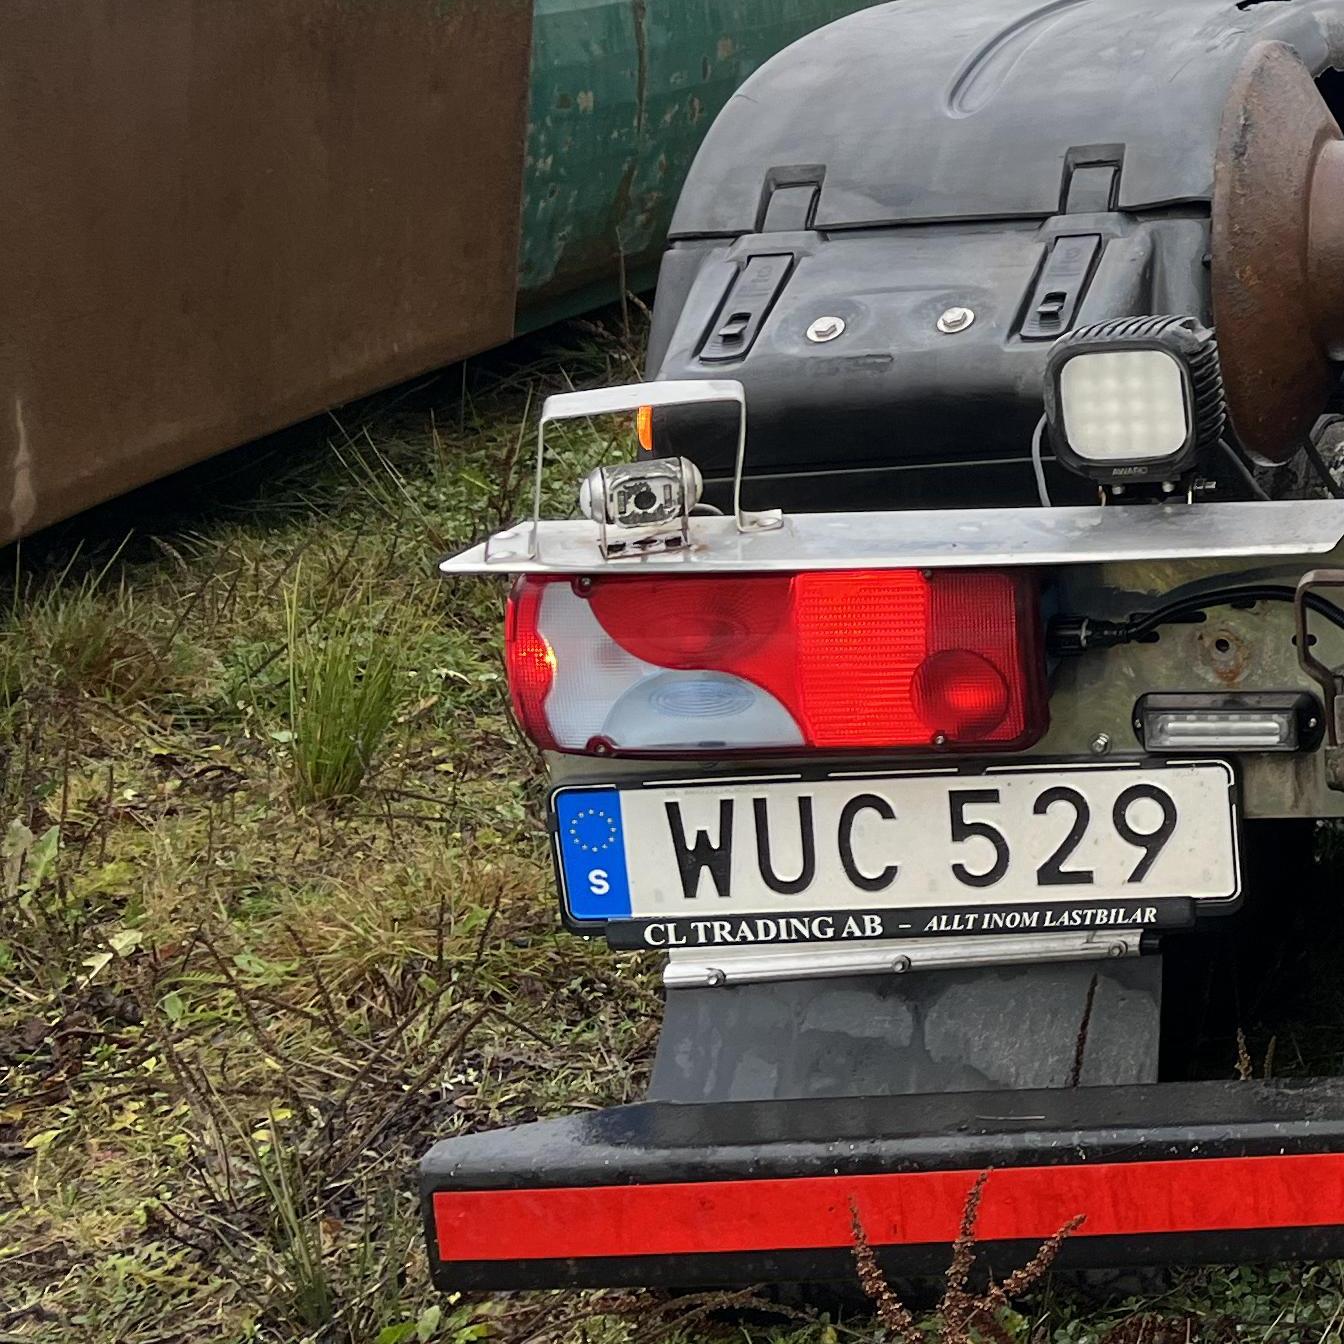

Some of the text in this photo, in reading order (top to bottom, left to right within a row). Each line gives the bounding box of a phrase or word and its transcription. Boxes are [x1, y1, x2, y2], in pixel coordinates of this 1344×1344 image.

[664, 783, 1178, 899] WUC 529
[588, 869, 611, 895] S
[643, 922, 687, 946] CL
[690, 917, 835, 944] TRADING
[841, 914, 884, 938] AB
[923, 914, 979, 932] ALLT
[981, 912, 1040, 929] INOM
[1043, 907, 1157, 927] LASTBILAR
